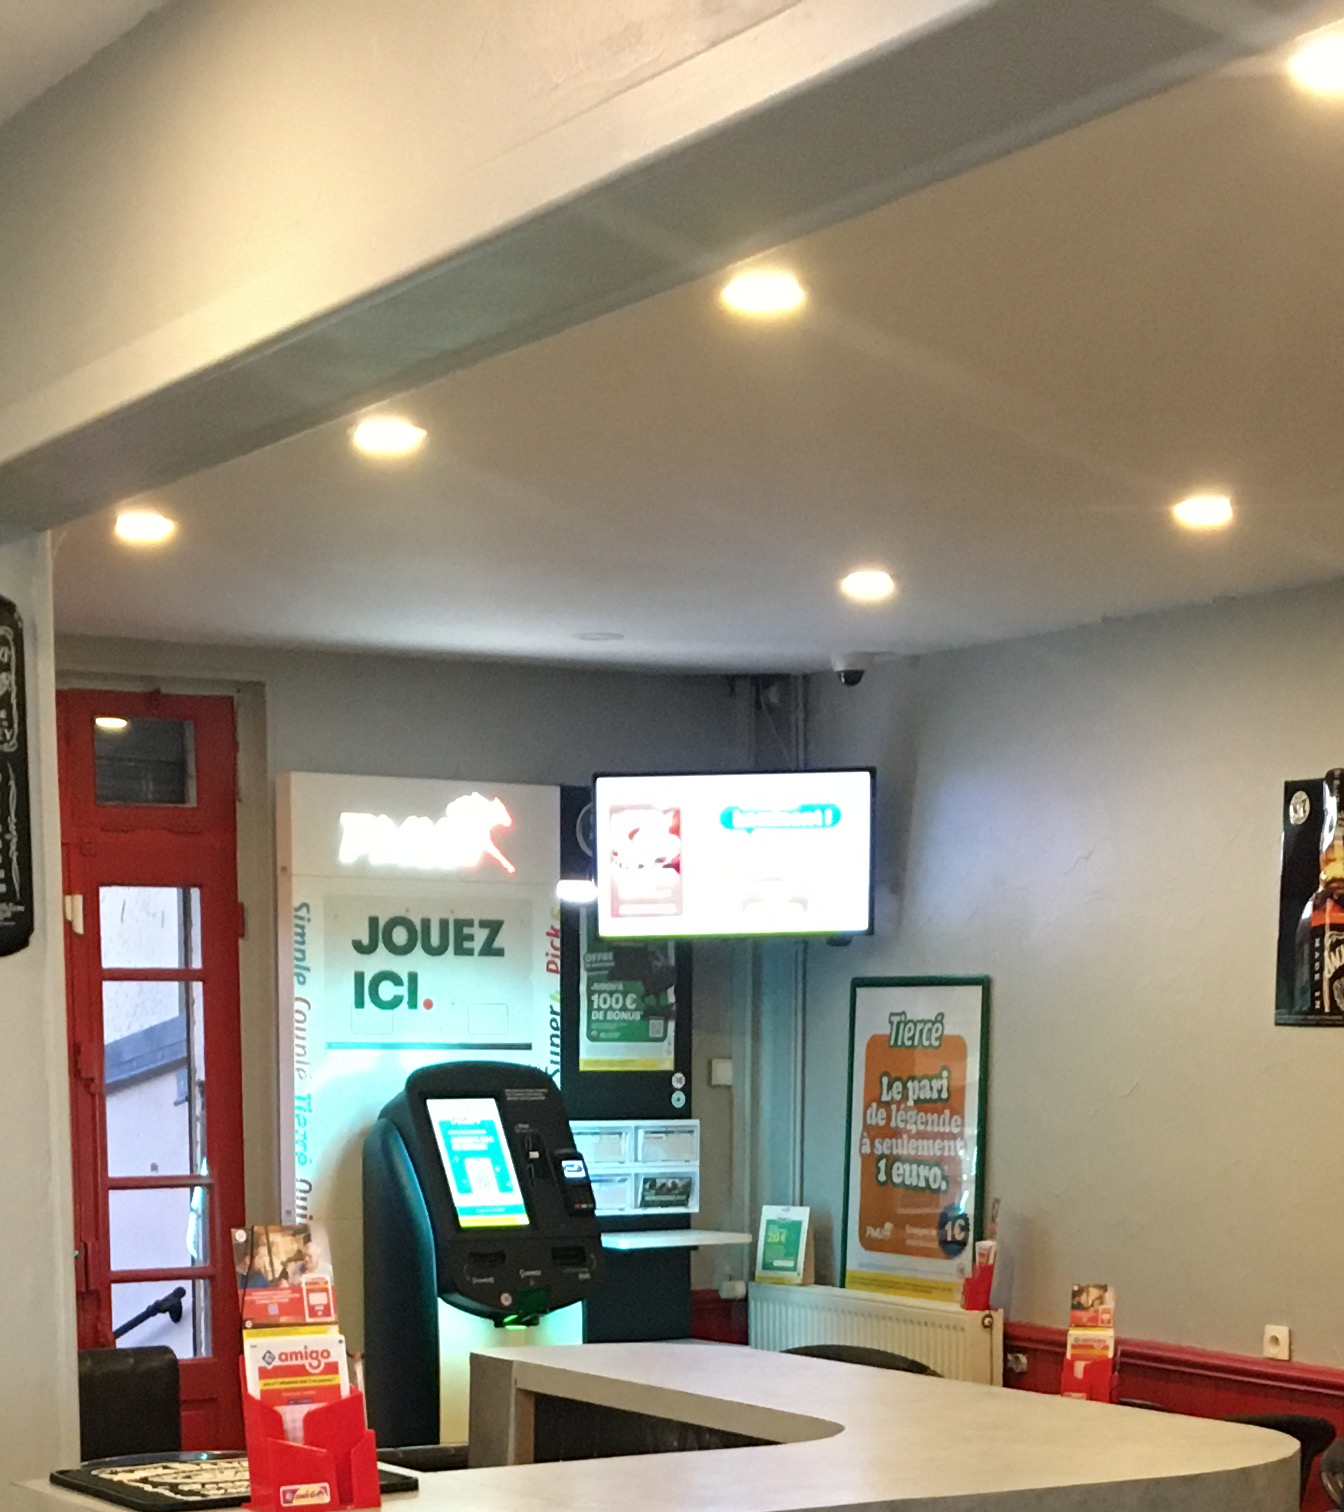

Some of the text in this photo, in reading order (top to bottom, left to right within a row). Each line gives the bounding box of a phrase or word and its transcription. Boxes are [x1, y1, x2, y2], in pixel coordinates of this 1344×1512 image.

[351, 915, 505, 957] JOUEZ
[353, 969, 434, 1011] ICI.
[591, 1010, 605, 1020] DE
[889, 1012, 944, 1047] Tiercé
[881, 1069, 950, 1107] Le pari
[866, 1102, 962, 1135] de légende
[861, 1134, 965, 1157] à seulement
[878, 1157, 948, 1191] 1 euro.
[278, 1345, 331, 1370] amigo
